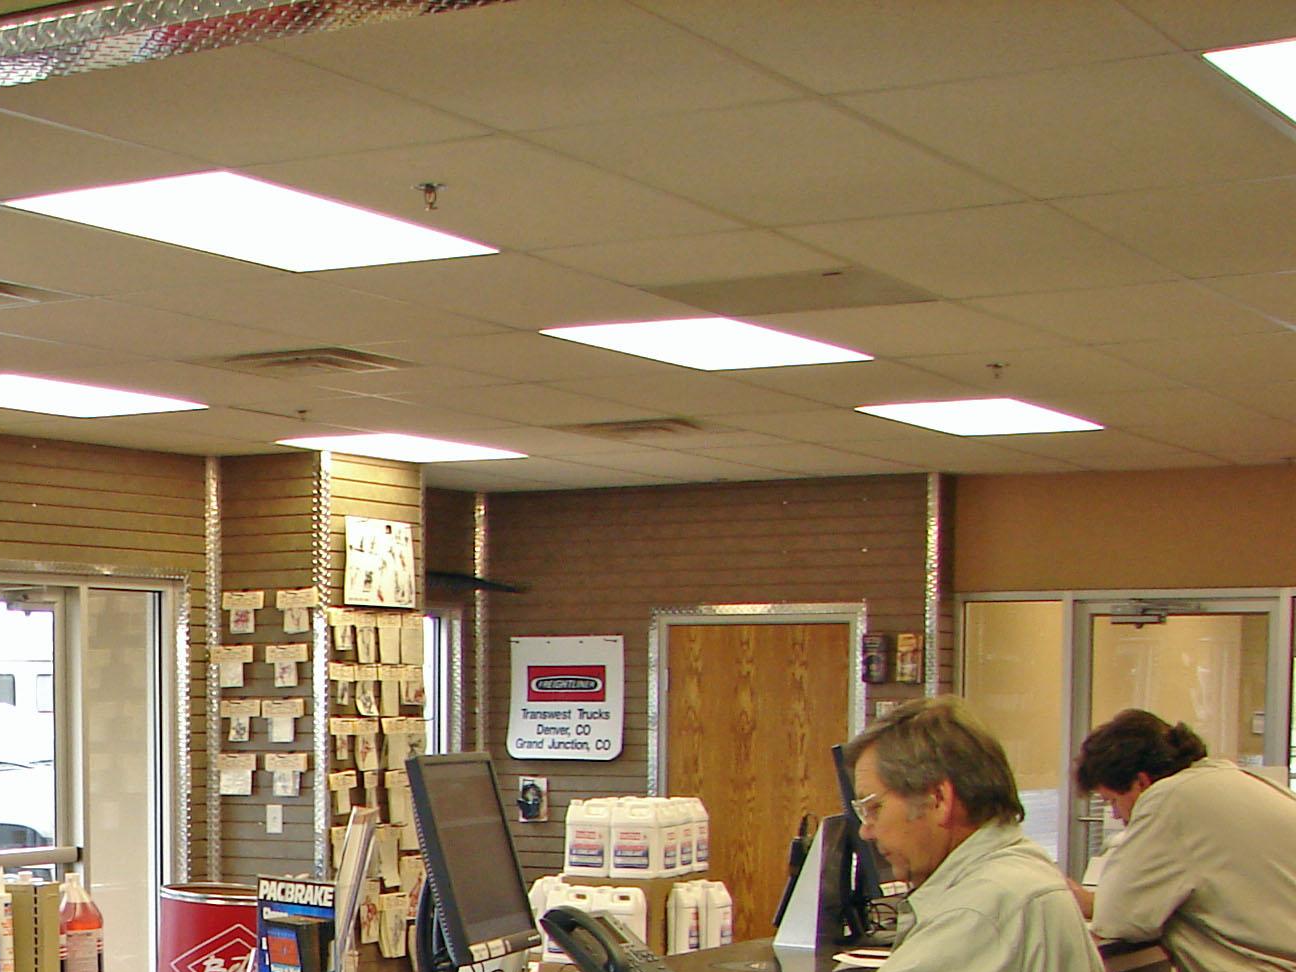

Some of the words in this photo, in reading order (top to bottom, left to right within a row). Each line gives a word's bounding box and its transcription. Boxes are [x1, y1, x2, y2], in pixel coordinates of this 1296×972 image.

[521, 708, 571, 720] Transwest
[577, 708, 610, 720] Trucks
[536, 724, 571, 736] Denver,
[576, 724, 591, 736] CO
[515, 738, 544, 749] Grand
[548, 739, 590, 751] Junction,
[595, 739, 611, 750] CO
[259, 880, 334, 907] PACBRAKE
